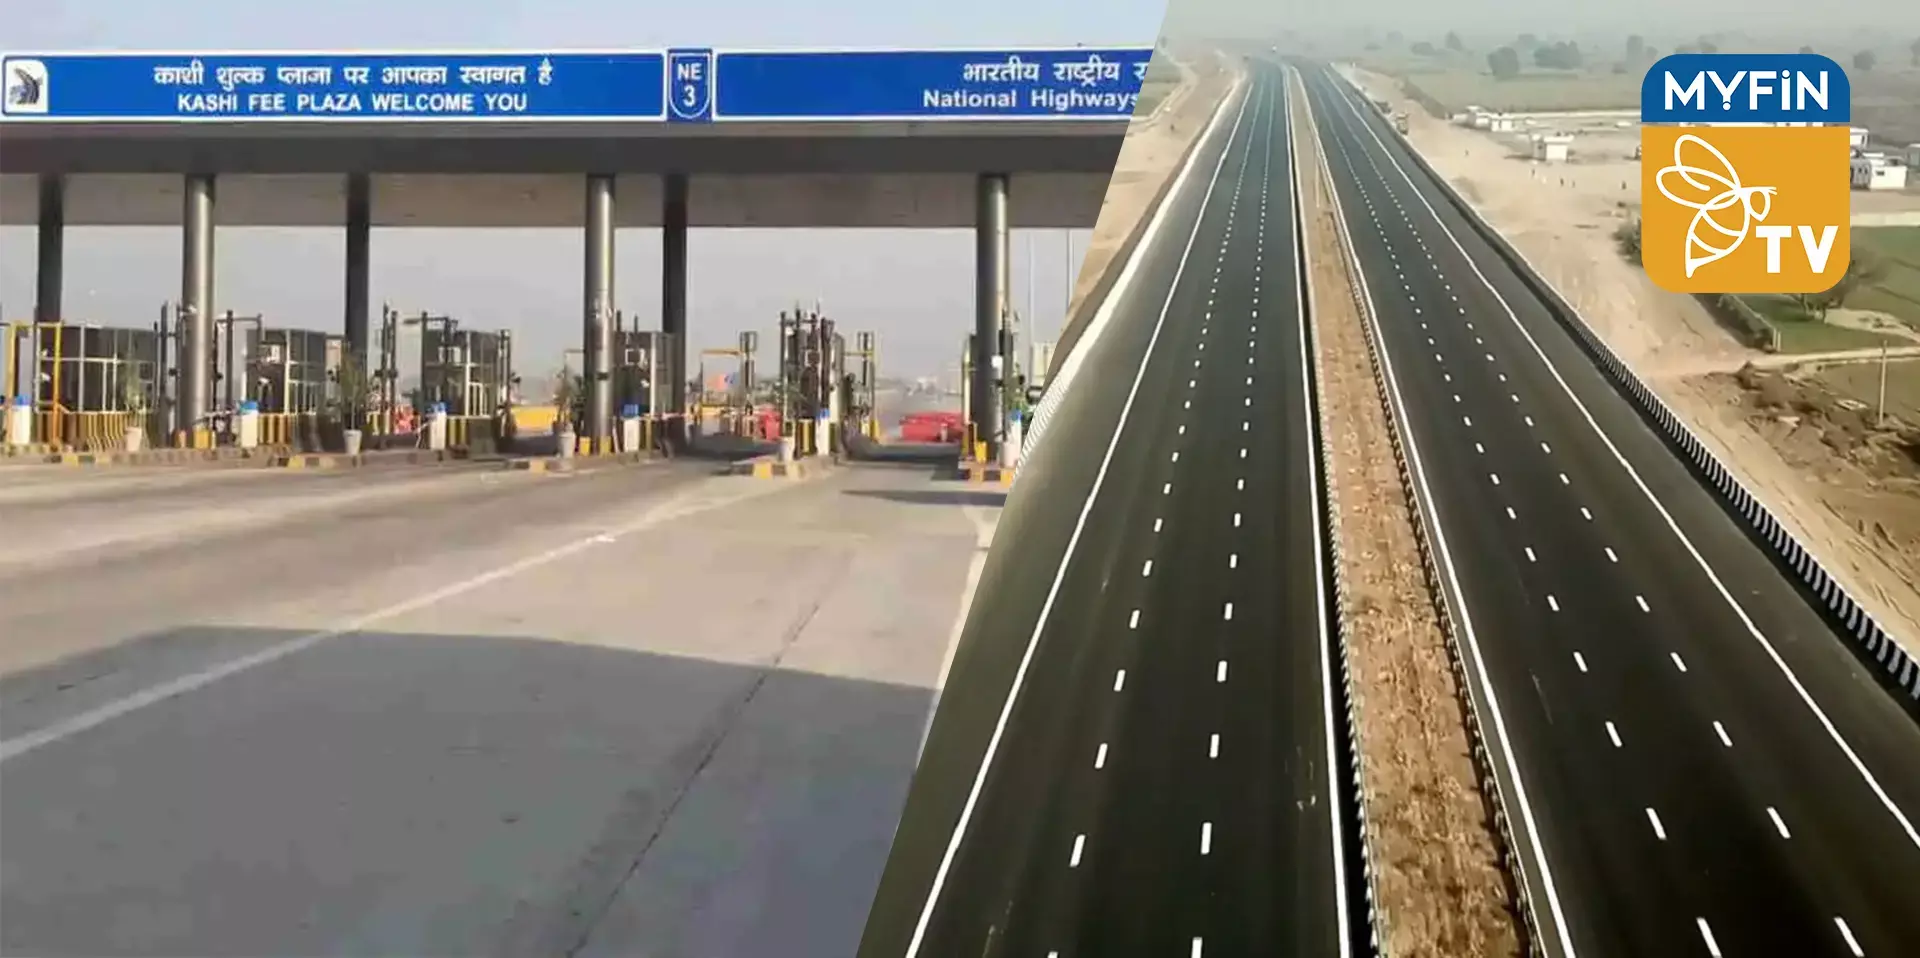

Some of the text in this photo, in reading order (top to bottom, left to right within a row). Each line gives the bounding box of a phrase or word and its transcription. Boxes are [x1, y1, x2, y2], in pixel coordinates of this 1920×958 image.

[153, 57, 553, 92] काशी शुल्क प्लाजा पर आपका स्वागत है
[677, 62, 702, 81] NE
[962, 55, 1040, 82] भारतीय
[1053, 54, 1120, 87] राष्ट्रीय
[177, 94, 528, 112] KASHI FEE PLAZA WELCOME YOU
[683, 85, 695, 107] 3
[923, 89, 1138, 111] National Highways
